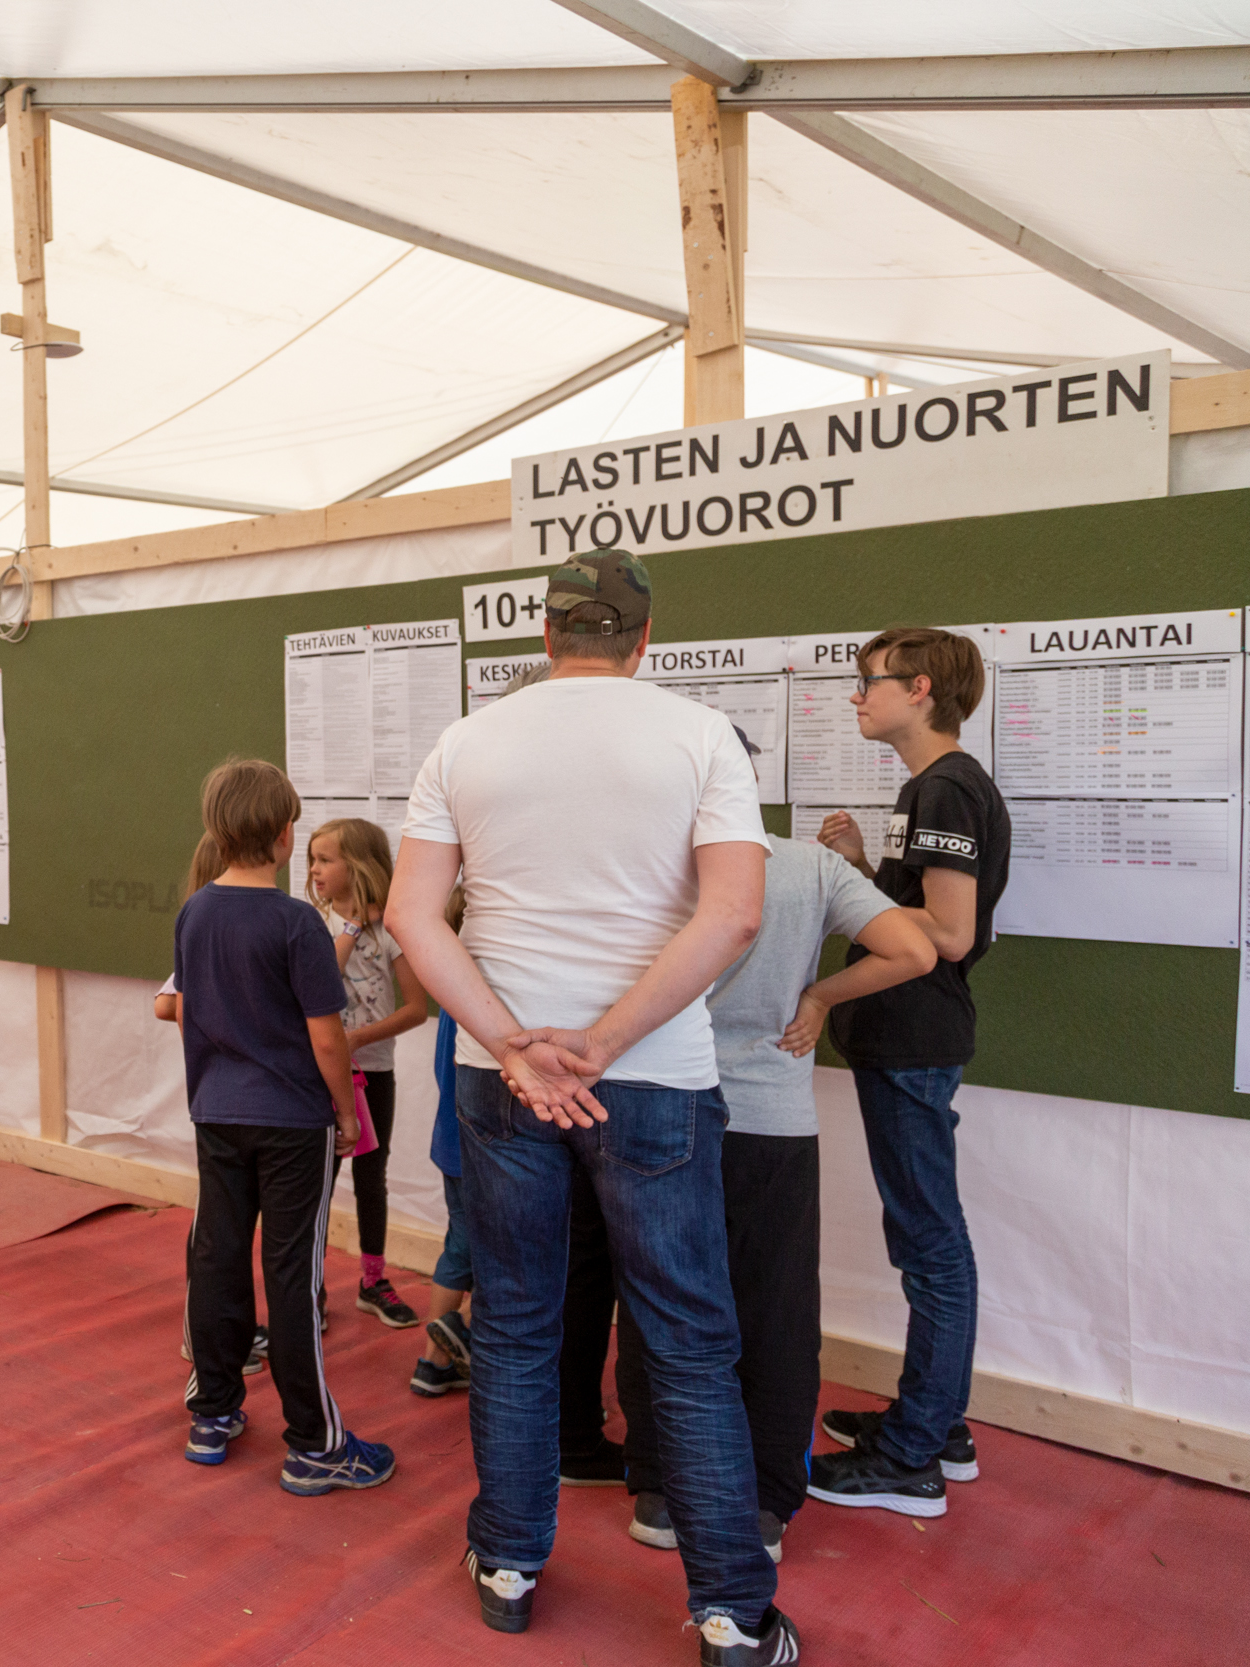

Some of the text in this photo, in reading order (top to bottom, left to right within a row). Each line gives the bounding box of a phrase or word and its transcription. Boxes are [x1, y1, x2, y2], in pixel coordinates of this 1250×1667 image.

[531, 363, 1153, 501] LASTEN JA NUORTEN
[530, 478, 855, 557] TYÖVUOROT
[473, 591, 543, 630] 10+
[289, 624, 450, 652] TEHTÄVIEN KUVAUKSET
[814, 642, 860, 664] PER
[1029, 622, 1194, 654] LAUANTAI
[648, 648, 745, 672] TORSTAI
[918, 833, 972, 854] HEYOO
